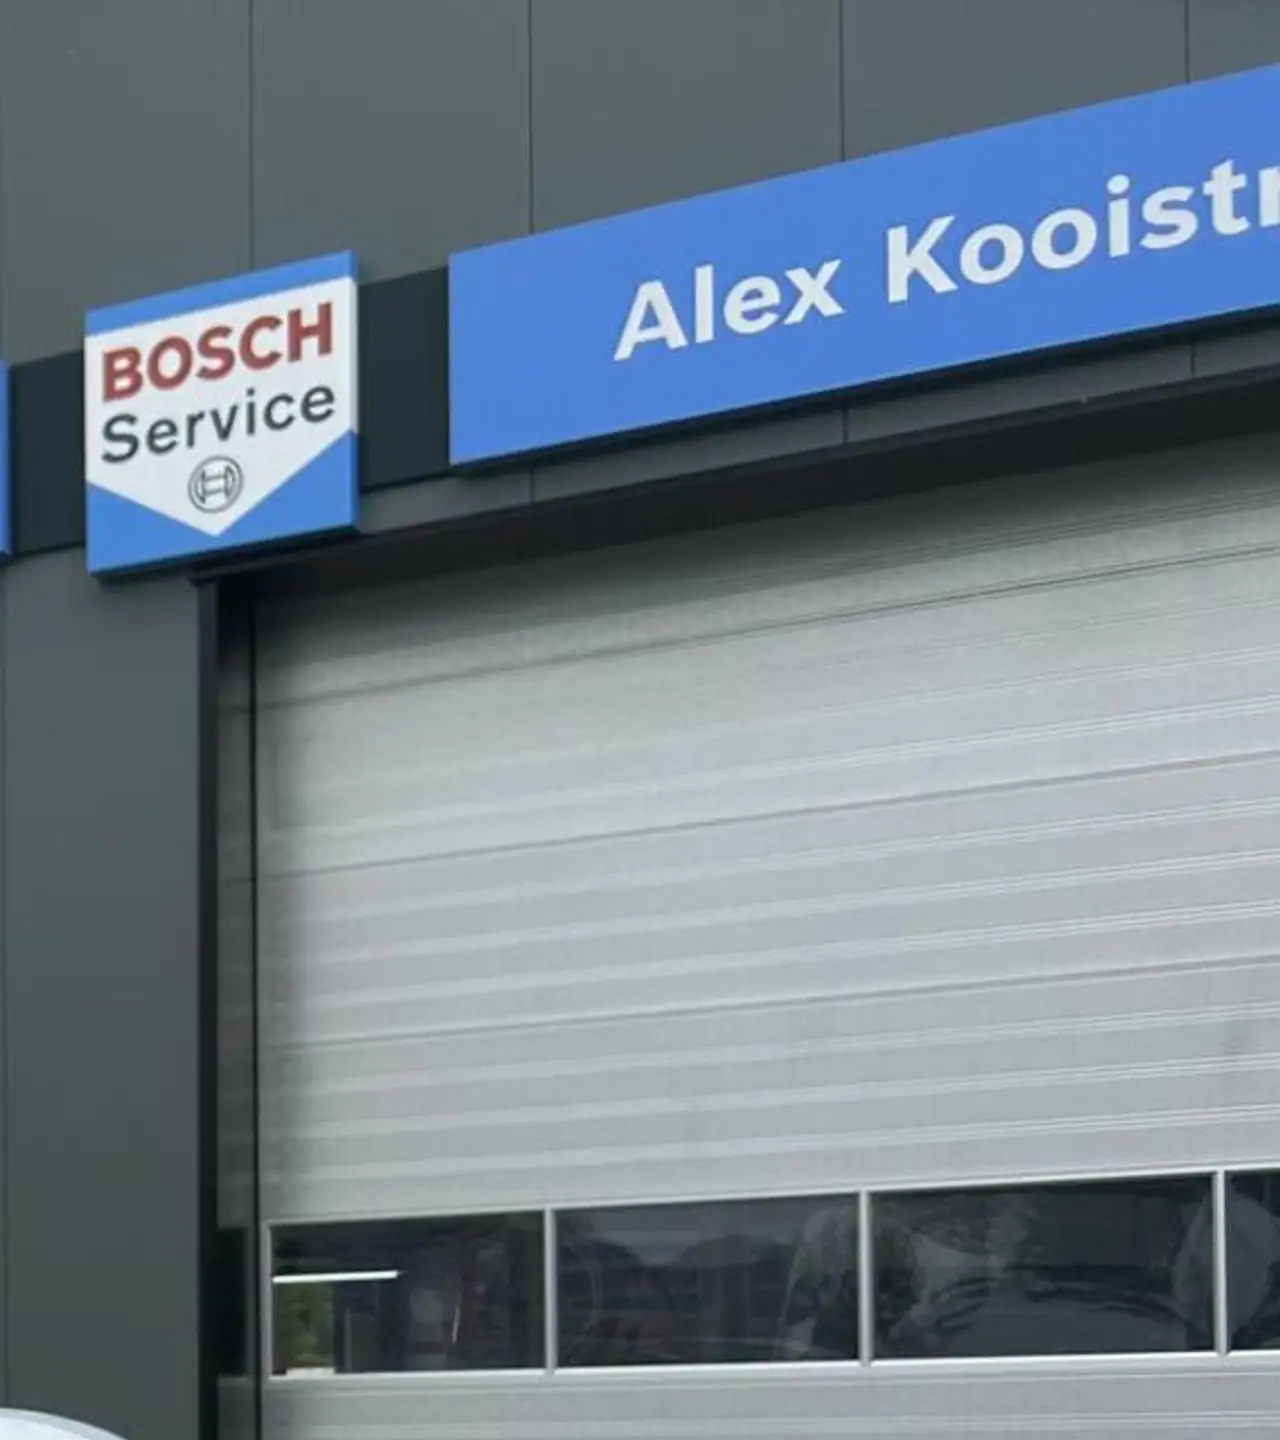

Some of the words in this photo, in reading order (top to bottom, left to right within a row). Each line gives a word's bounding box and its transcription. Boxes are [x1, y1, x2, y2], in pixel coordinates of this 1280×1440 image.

[101, 301, 332, 401] BOSCH
[613, 257, 845, 361] Alex
[101, 385, 334, 464] Service
